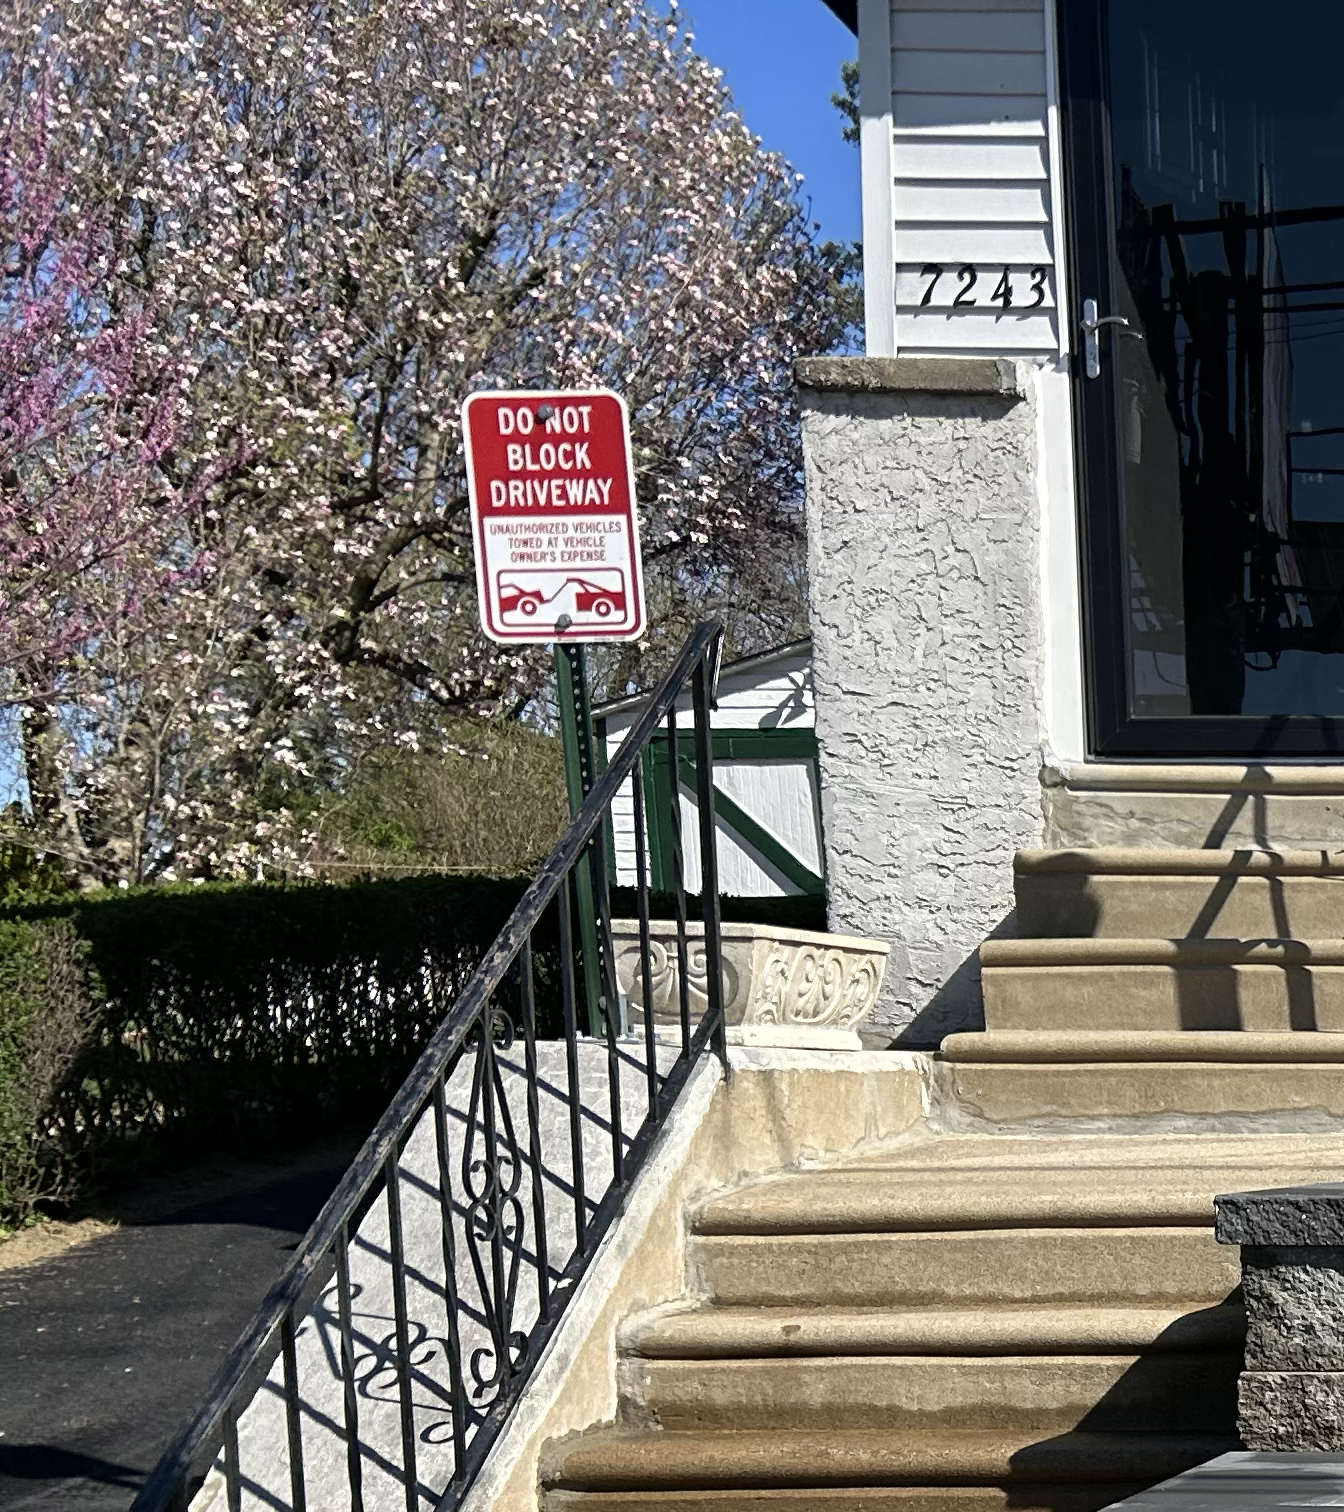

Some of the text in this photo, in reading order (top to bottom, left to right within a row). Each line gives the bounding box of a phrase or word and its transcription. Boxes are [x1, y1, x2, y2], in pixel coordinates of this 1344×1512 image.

[920, 264, 1048, 311] 7243
[497, 405, 592, 436] DO NOT
[506, 441, 593, 472] BLOCK
[489, 477, 614, 508] DRIVEWAY
[489, 520, 622, 536] UNAUTHORIZED VEHICLES
[508, 535, 606, 549] TOWED AT VEHICLE
[510, 549, 607, 564] OWNER'S EXPENSE
